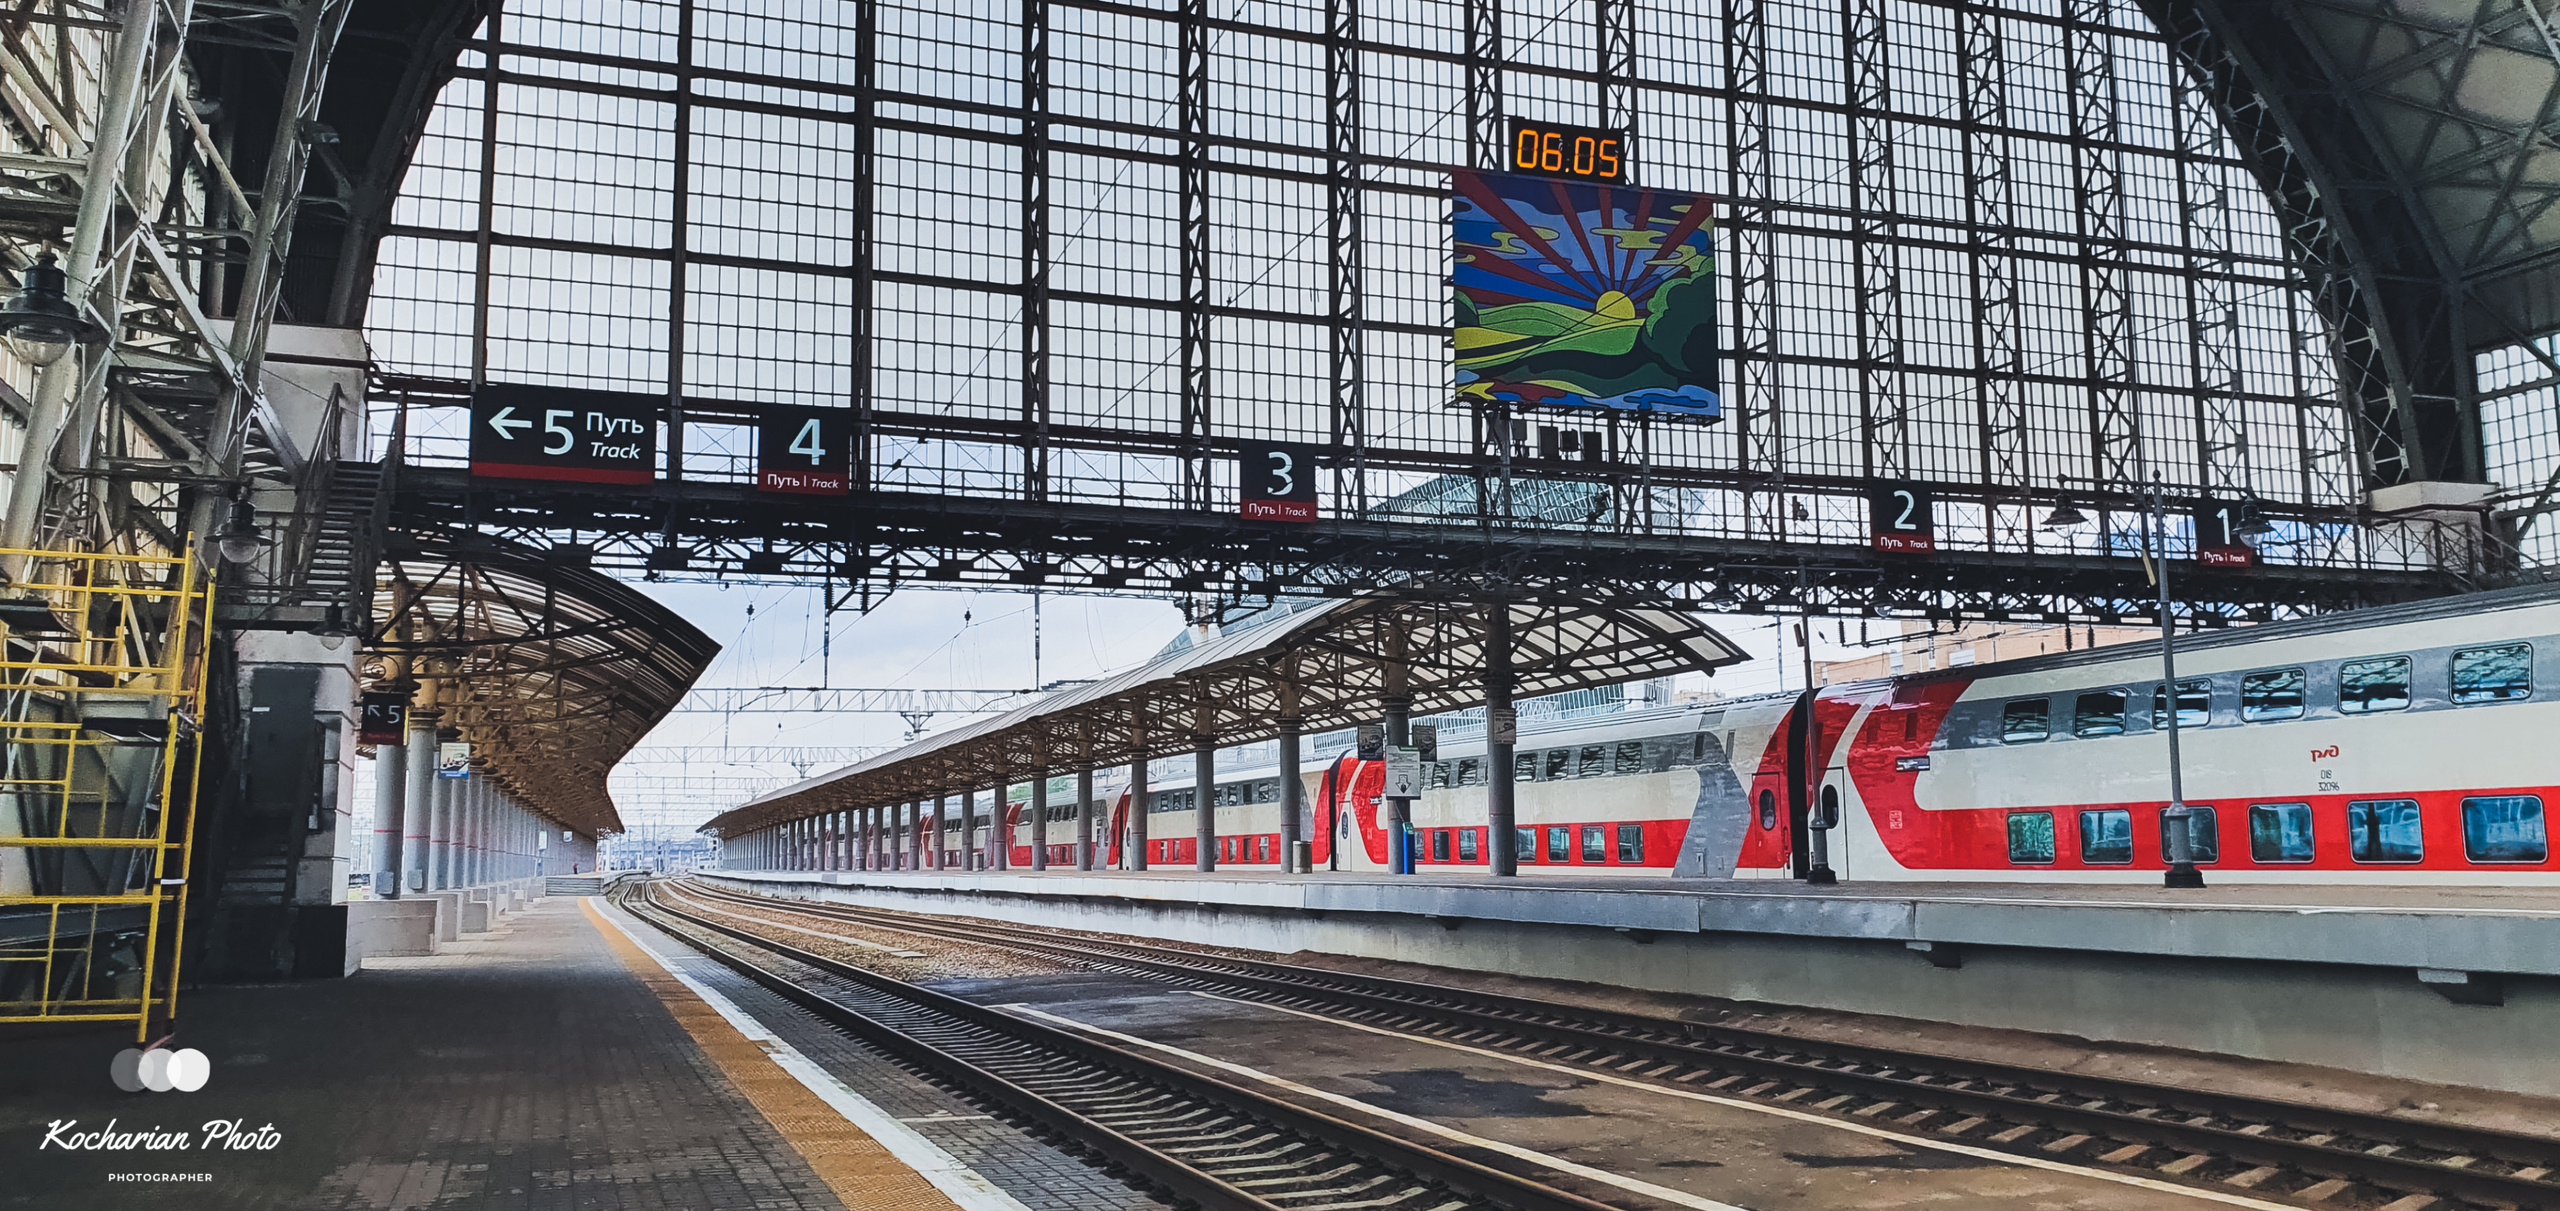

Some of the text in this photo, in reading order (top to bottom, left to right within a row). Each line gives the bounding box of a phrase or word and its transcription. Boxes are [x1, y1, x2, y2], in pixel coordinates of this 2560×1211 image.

[542, 408, 645, 456] 5 Путь
[788, 418, 826, 466] 4
[590, 441, 641, 461] Track
[767, 473, 839, 489] Путь Track
[1267, 451, 1294, 496] 3
[1248, 502, 1308, 517] Путь Track
[1893, 489, 1917, 530] 2
[2216, 507, 2231, 546] 1
[1880, 536, 1929, 550] Путь Track
[2203, 551, 2224, 564] Путь
[386, 705, 401, 724] 5
